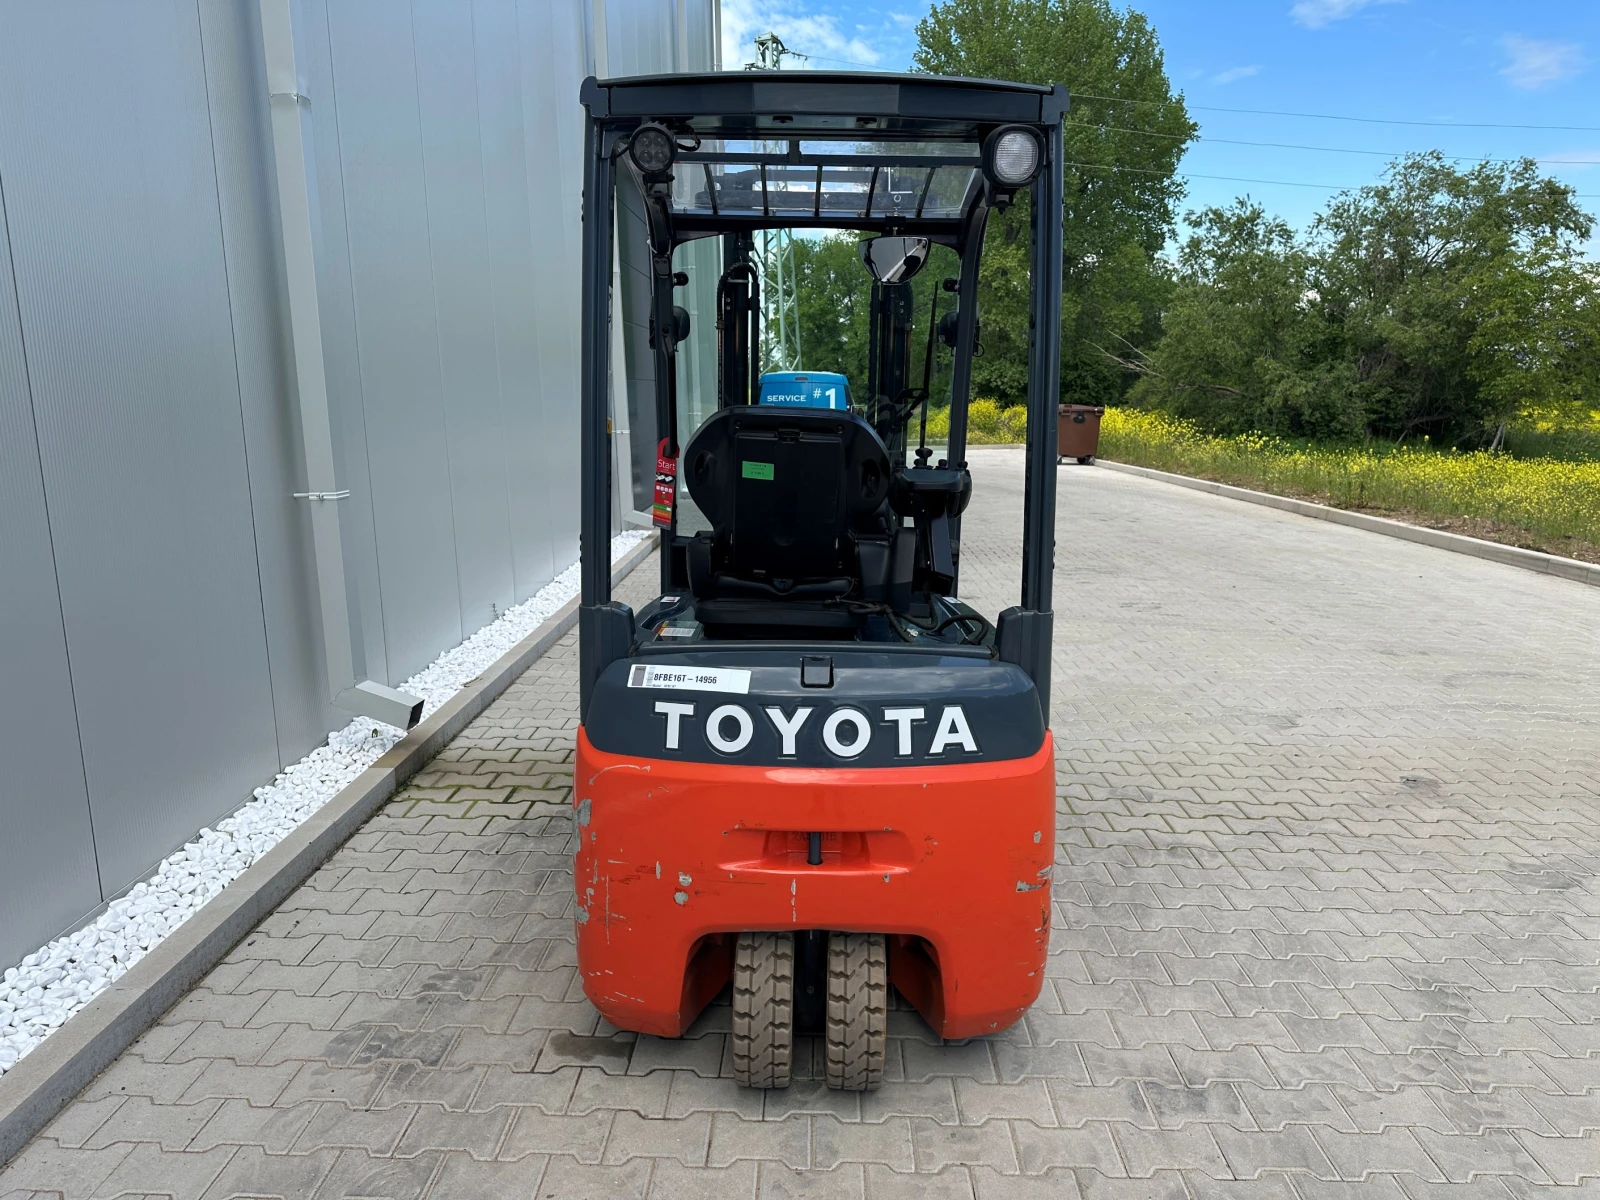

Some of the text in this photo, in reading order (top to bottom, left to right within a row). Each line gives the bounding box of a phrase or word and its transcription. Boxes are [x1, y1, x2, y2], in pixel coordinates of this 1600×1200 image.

[767, 394, 807, 402] SERVICE
[657, 459, 676, 471] Start
[655, 701, 978, 757] TOYOTA
